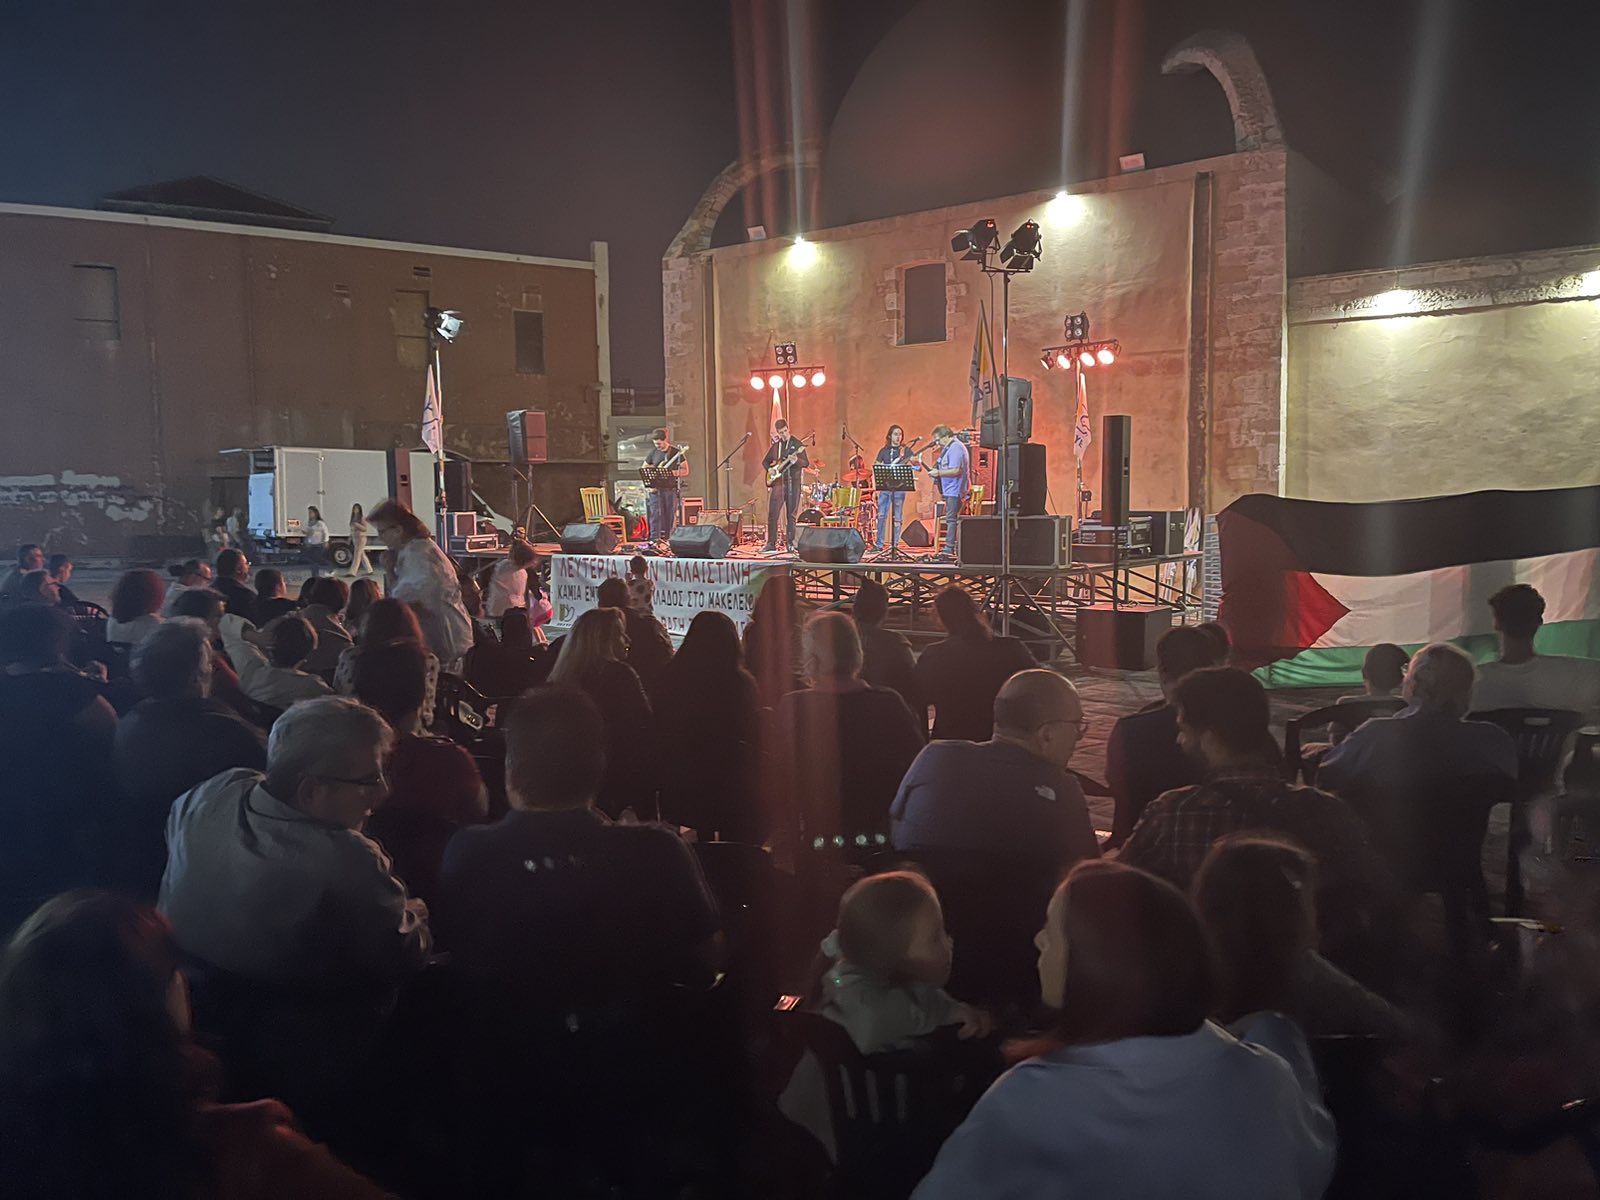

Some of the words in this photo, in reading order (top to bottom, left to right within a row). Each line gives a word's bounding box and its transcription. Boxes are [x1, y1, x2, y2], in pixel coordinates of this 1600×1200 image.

[624, 559, 658, 582] ΣΝ
[665, 560, 752, 585] ΠΑΛΑΙΣΤΙΝΗ
[558, 584, 582, 601] ΚΑΜΙΑ
[687, 591, 705, 608] ΣΤΟ
